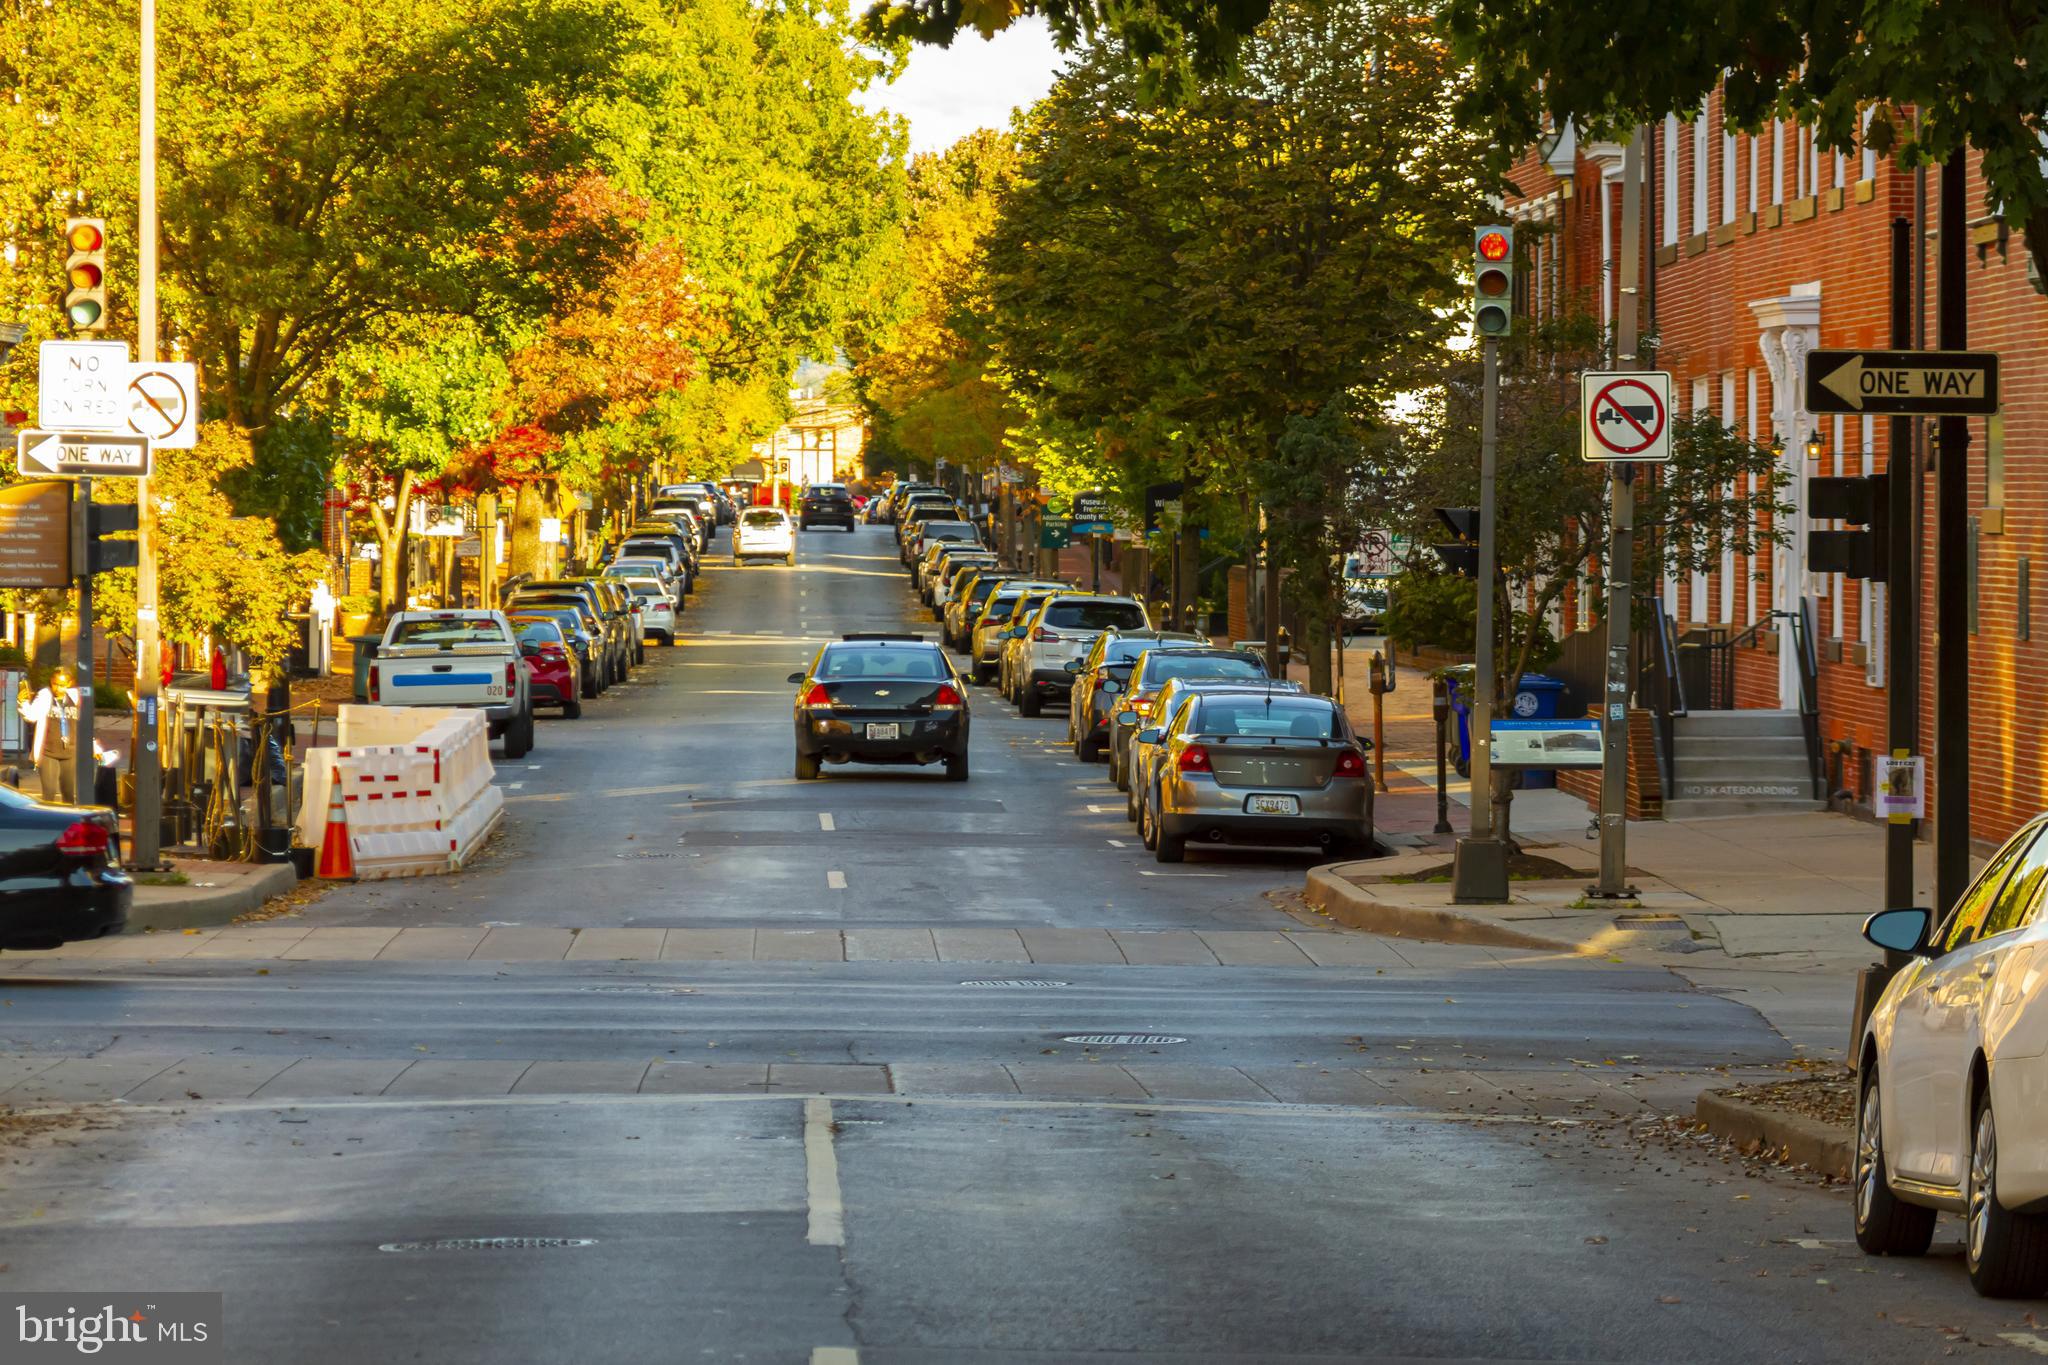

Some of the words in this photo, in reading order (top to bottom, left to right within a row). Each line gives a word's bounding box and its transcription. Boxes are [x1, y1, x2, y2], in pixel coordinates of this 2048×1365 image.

[69, 356, 100, 372] NO
[1859, 370, 1910, 394] ONE
[1923, 371, 1977, 396] WAY
[50, 399, 74, 414] ON
[82, 399, 118, 415] RED
[56, 446, 90, 462] ONE
[99, 447, 133, 463] WAY
[1074, 513, 1097, 522] County
[1683, 785, 1701, 795] NO
[1703, 785, 1799, 796] SKATEBOARDING
